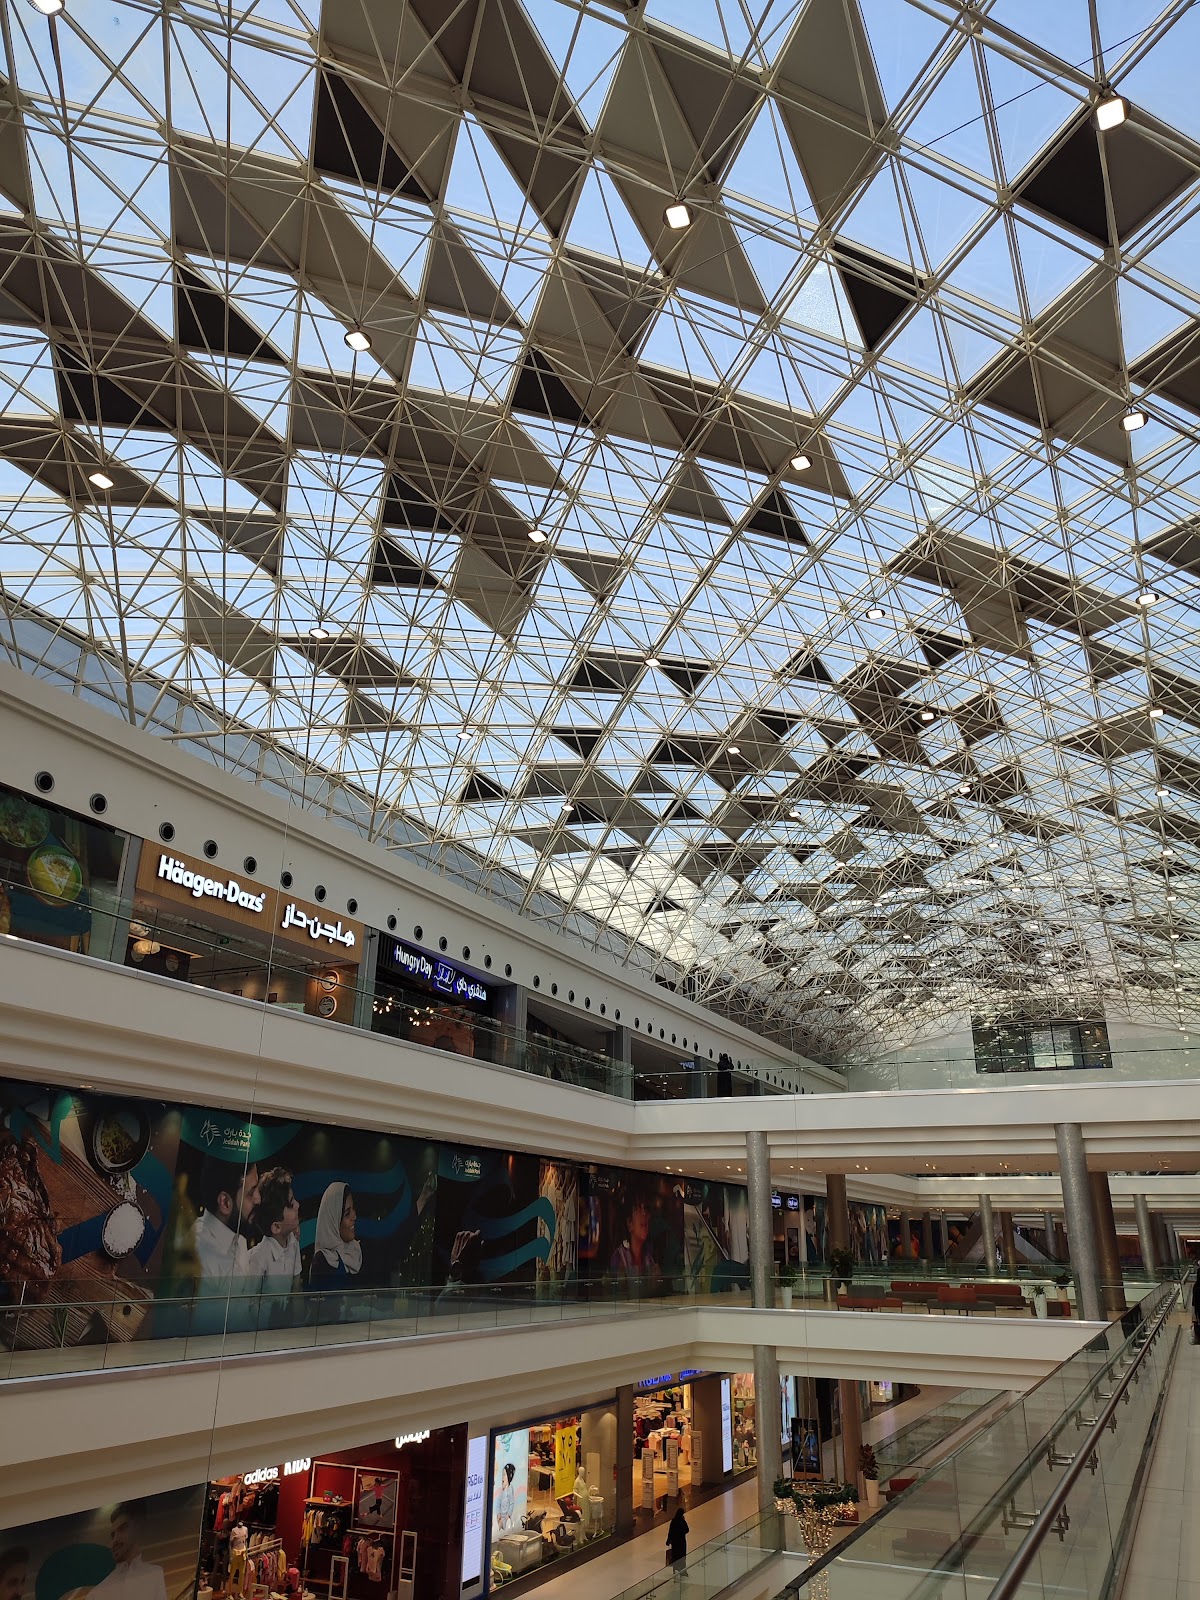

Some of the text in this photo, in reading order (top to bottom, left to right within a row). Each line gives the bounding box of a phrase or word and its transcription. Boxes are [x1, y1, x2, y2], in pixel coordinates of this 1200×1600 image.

[158, 854, 265, 913] Häagen-Dazs
[395, 945, 421, 973] Hungry
[420, 956, 433, 979] Day
[223, 1138, 239, 1146] Jeddah
[244, 1466, 279, 1486] adidas
